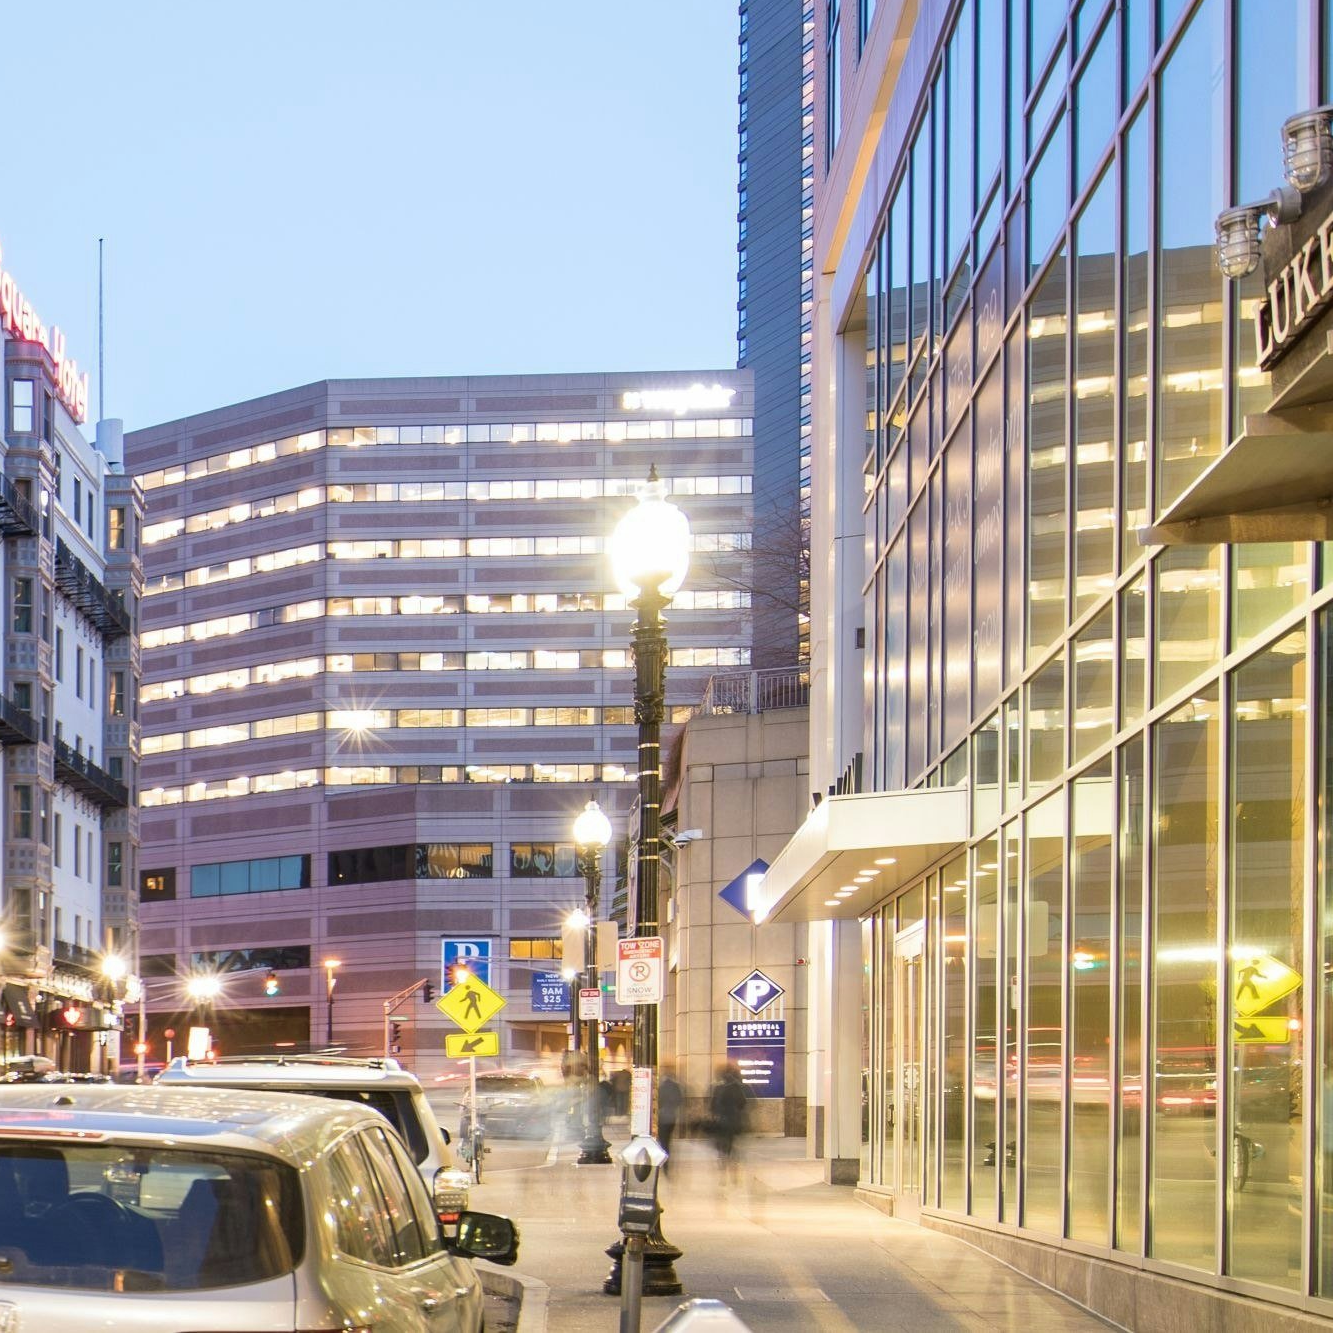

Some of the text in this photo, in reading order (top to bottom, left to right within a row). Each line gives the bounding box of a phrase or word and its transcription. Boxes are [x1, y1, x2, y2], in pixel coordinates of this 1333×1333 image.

[52, 325, 89, 424] Hotel
[620, 940, 660, 950] TOW ZONE
[541, 987, 563, 995] 9AM
[746, 979, 771, 1006] P
[543, 995, 562, 1003] $25
